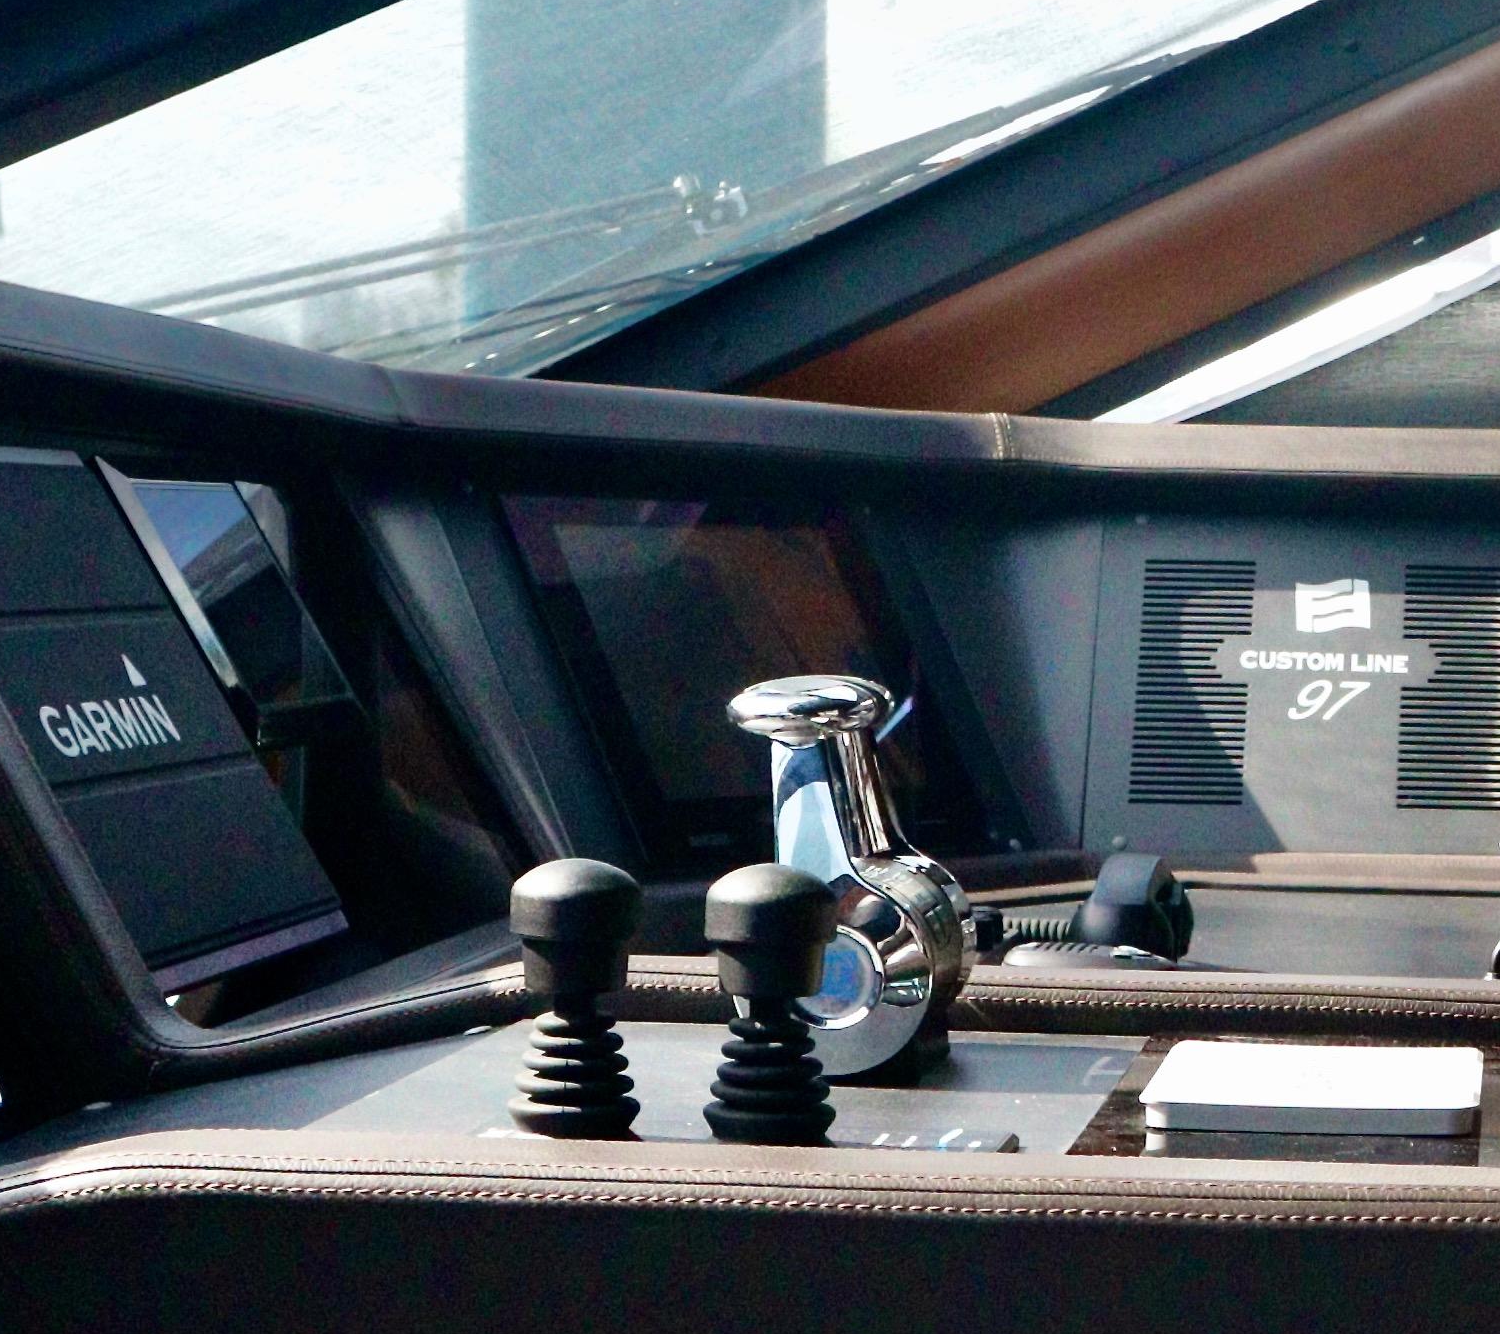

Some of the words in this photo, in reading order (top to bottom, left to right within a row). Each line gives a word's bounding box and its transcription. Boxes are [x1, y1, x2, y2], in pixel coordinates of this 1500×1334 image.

[1239, 649, 1344, 672] CUSTOM
[1350, 652, 1410, 674] LINE
[1287, 678, 1371, 722] 97
[39, 694, 182, 758] GARMIN
